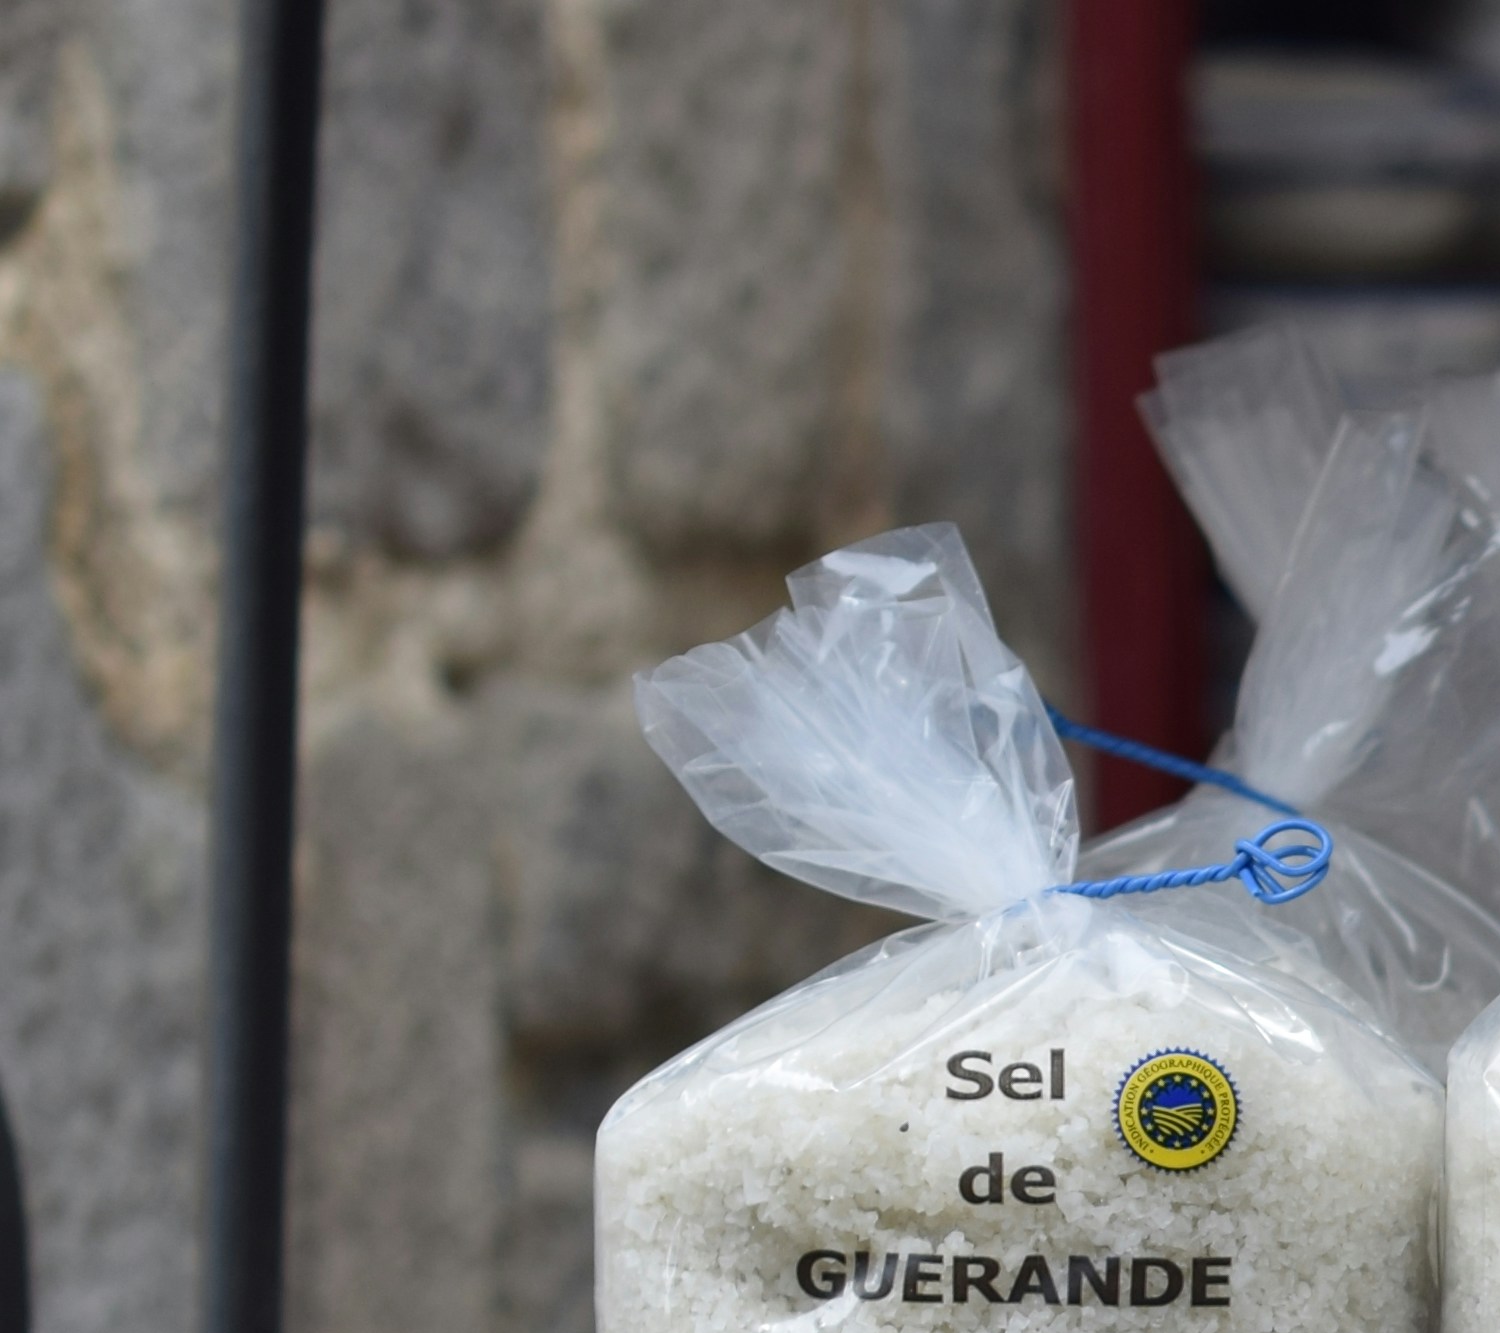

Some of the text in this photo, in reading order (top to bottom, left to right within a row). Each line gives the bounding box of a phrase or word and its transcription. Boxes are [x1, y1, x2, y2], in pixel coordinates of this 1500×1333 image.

[945, 1050, 1066, 1102] Sel
[1124, 1058, 1231, 1151] INDICATION GÉOGRAPHIQUE PROTÉGÉE
[958, 1153, 1056, 1206] de
[798, 1250, 1232, 1308] GUERANDE
